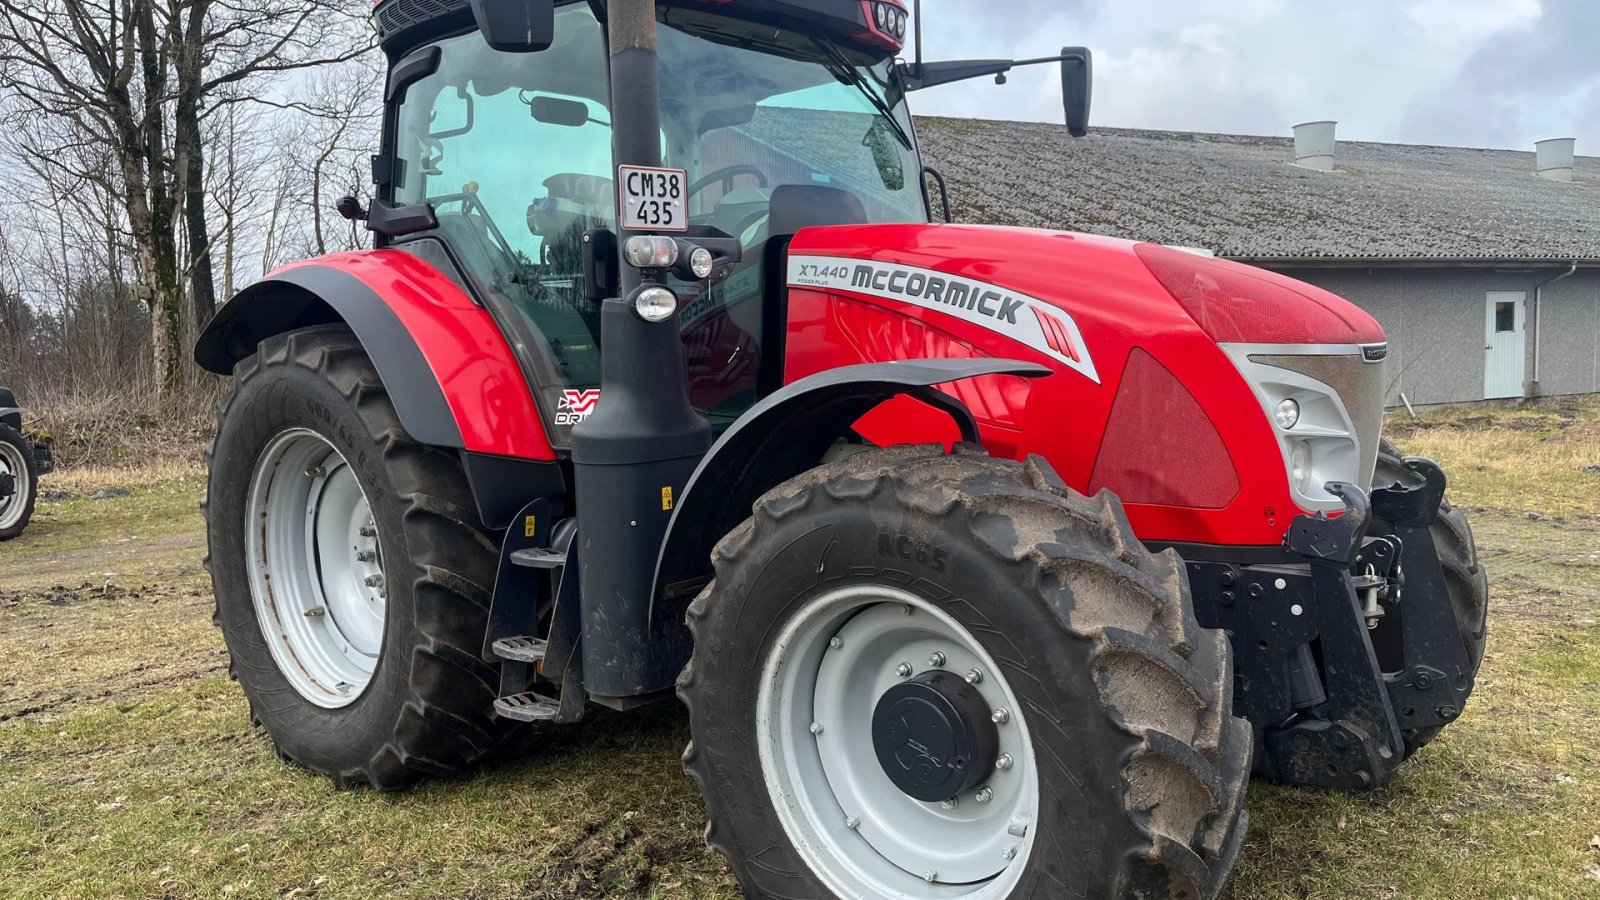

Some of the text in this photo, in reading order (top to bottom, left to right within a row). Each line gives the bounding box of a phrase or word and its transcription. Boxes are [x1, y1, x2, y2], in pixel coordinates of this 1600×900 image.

[627, 172, 680, 199] CM38
[637, 200, 673, 225] 435
[799, 264, 849, 279] X7.440
